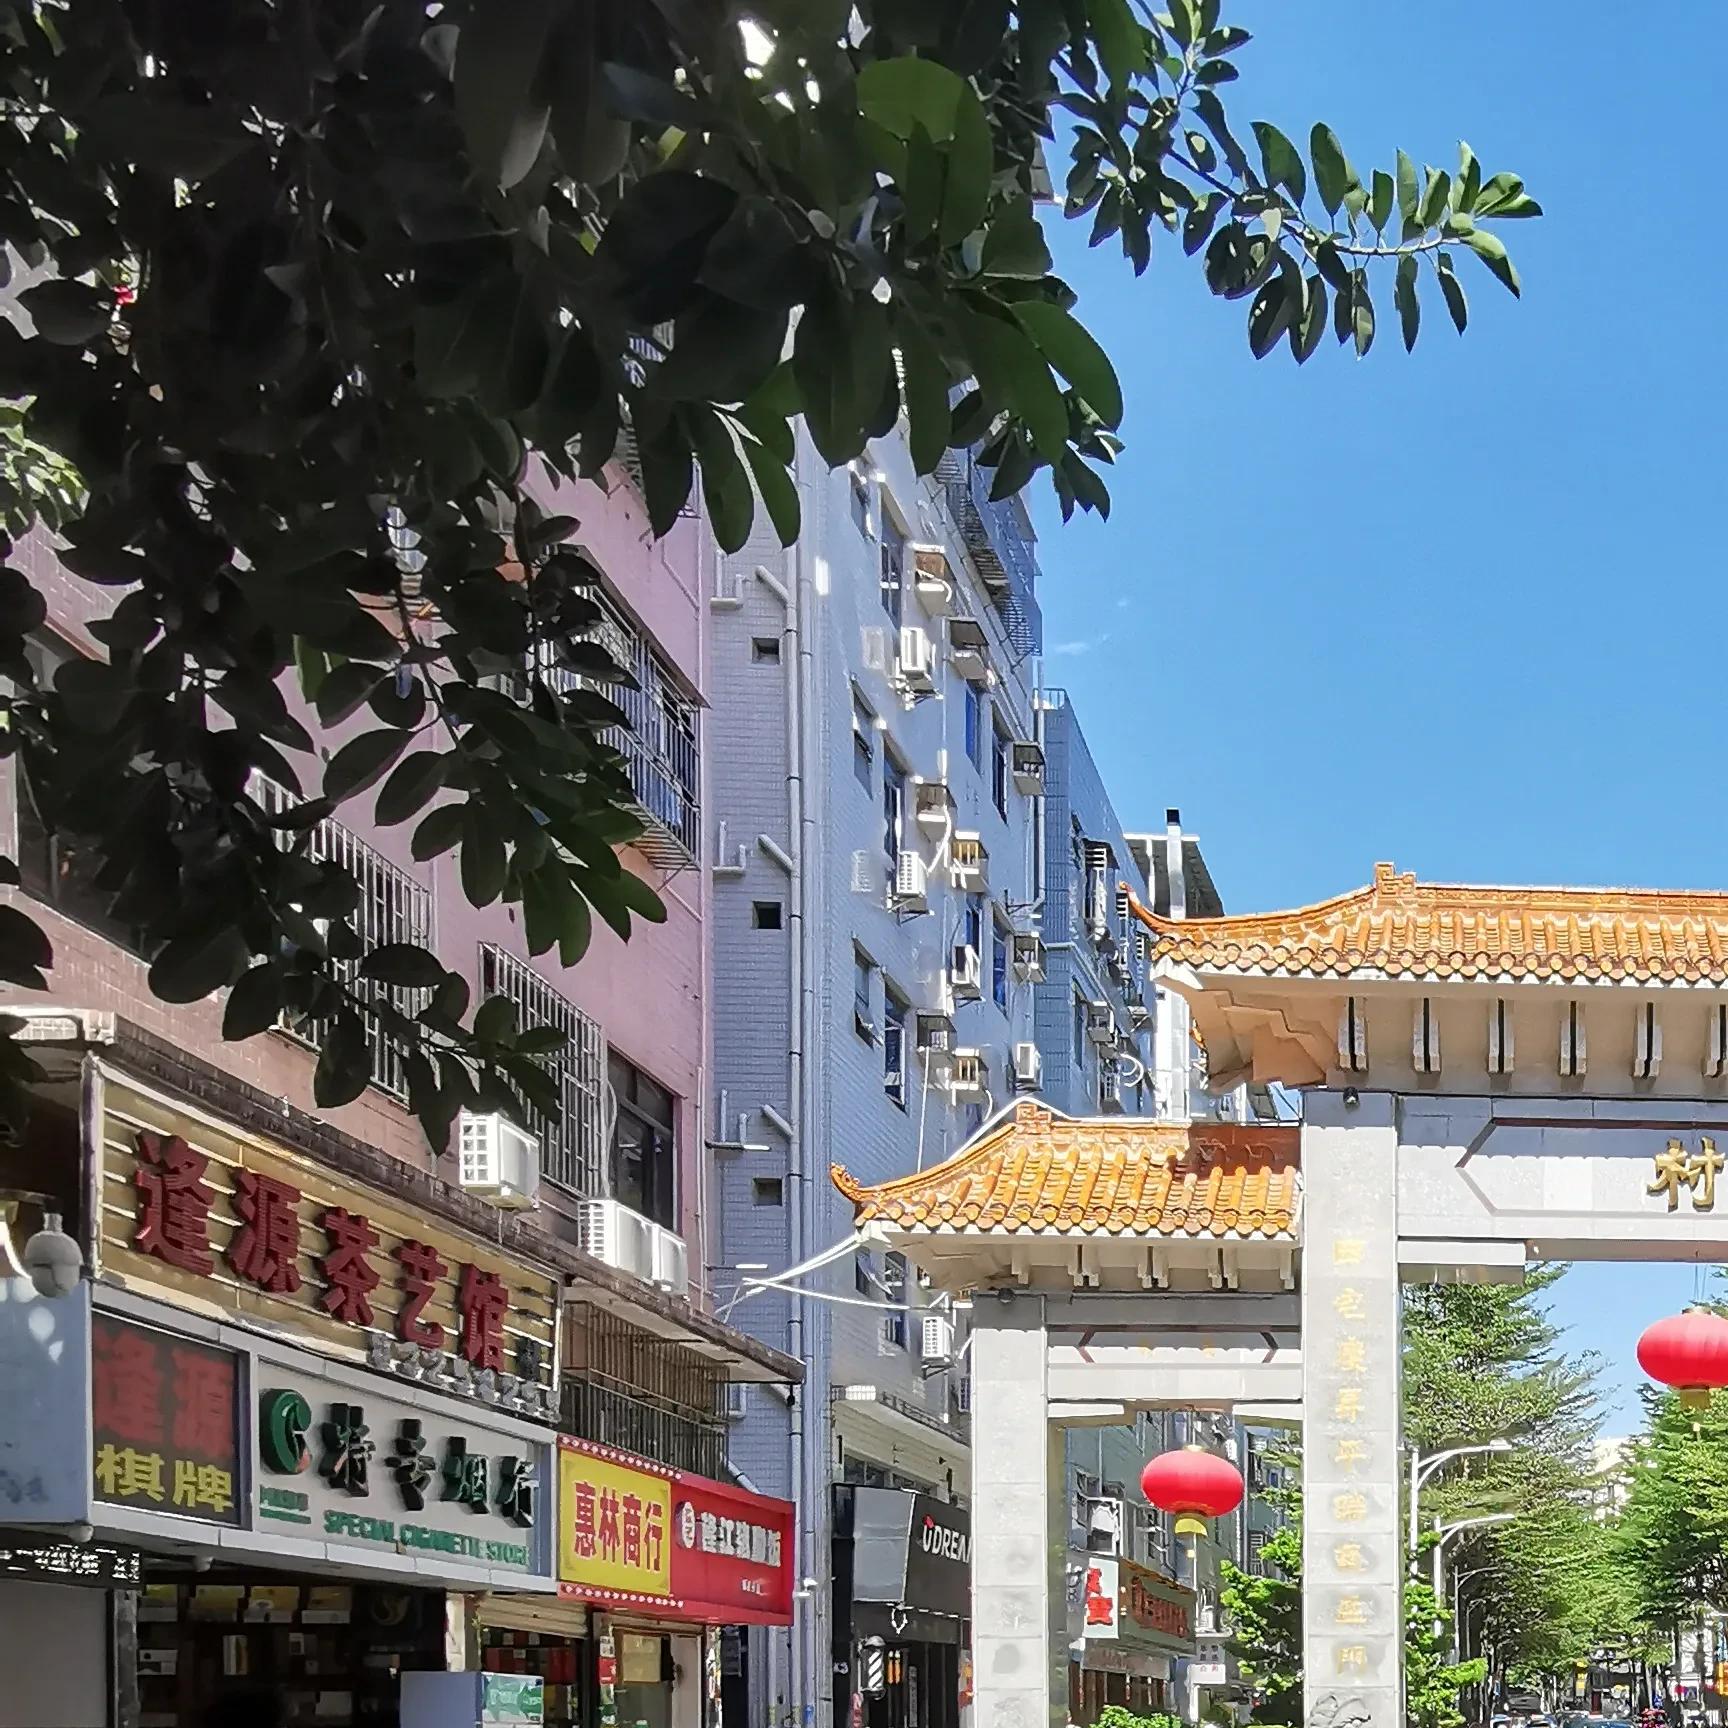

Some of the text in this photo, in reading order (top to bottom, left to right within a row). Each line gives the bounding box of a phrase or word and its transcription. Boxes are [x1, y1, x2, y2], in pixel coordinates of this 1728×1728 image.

[134, 1130, 509, 1374] 逢源茶艺馆
[96, 1444, 234, 1513] 棋牌
[574, 1481, 664, 1575] 惠林商行
